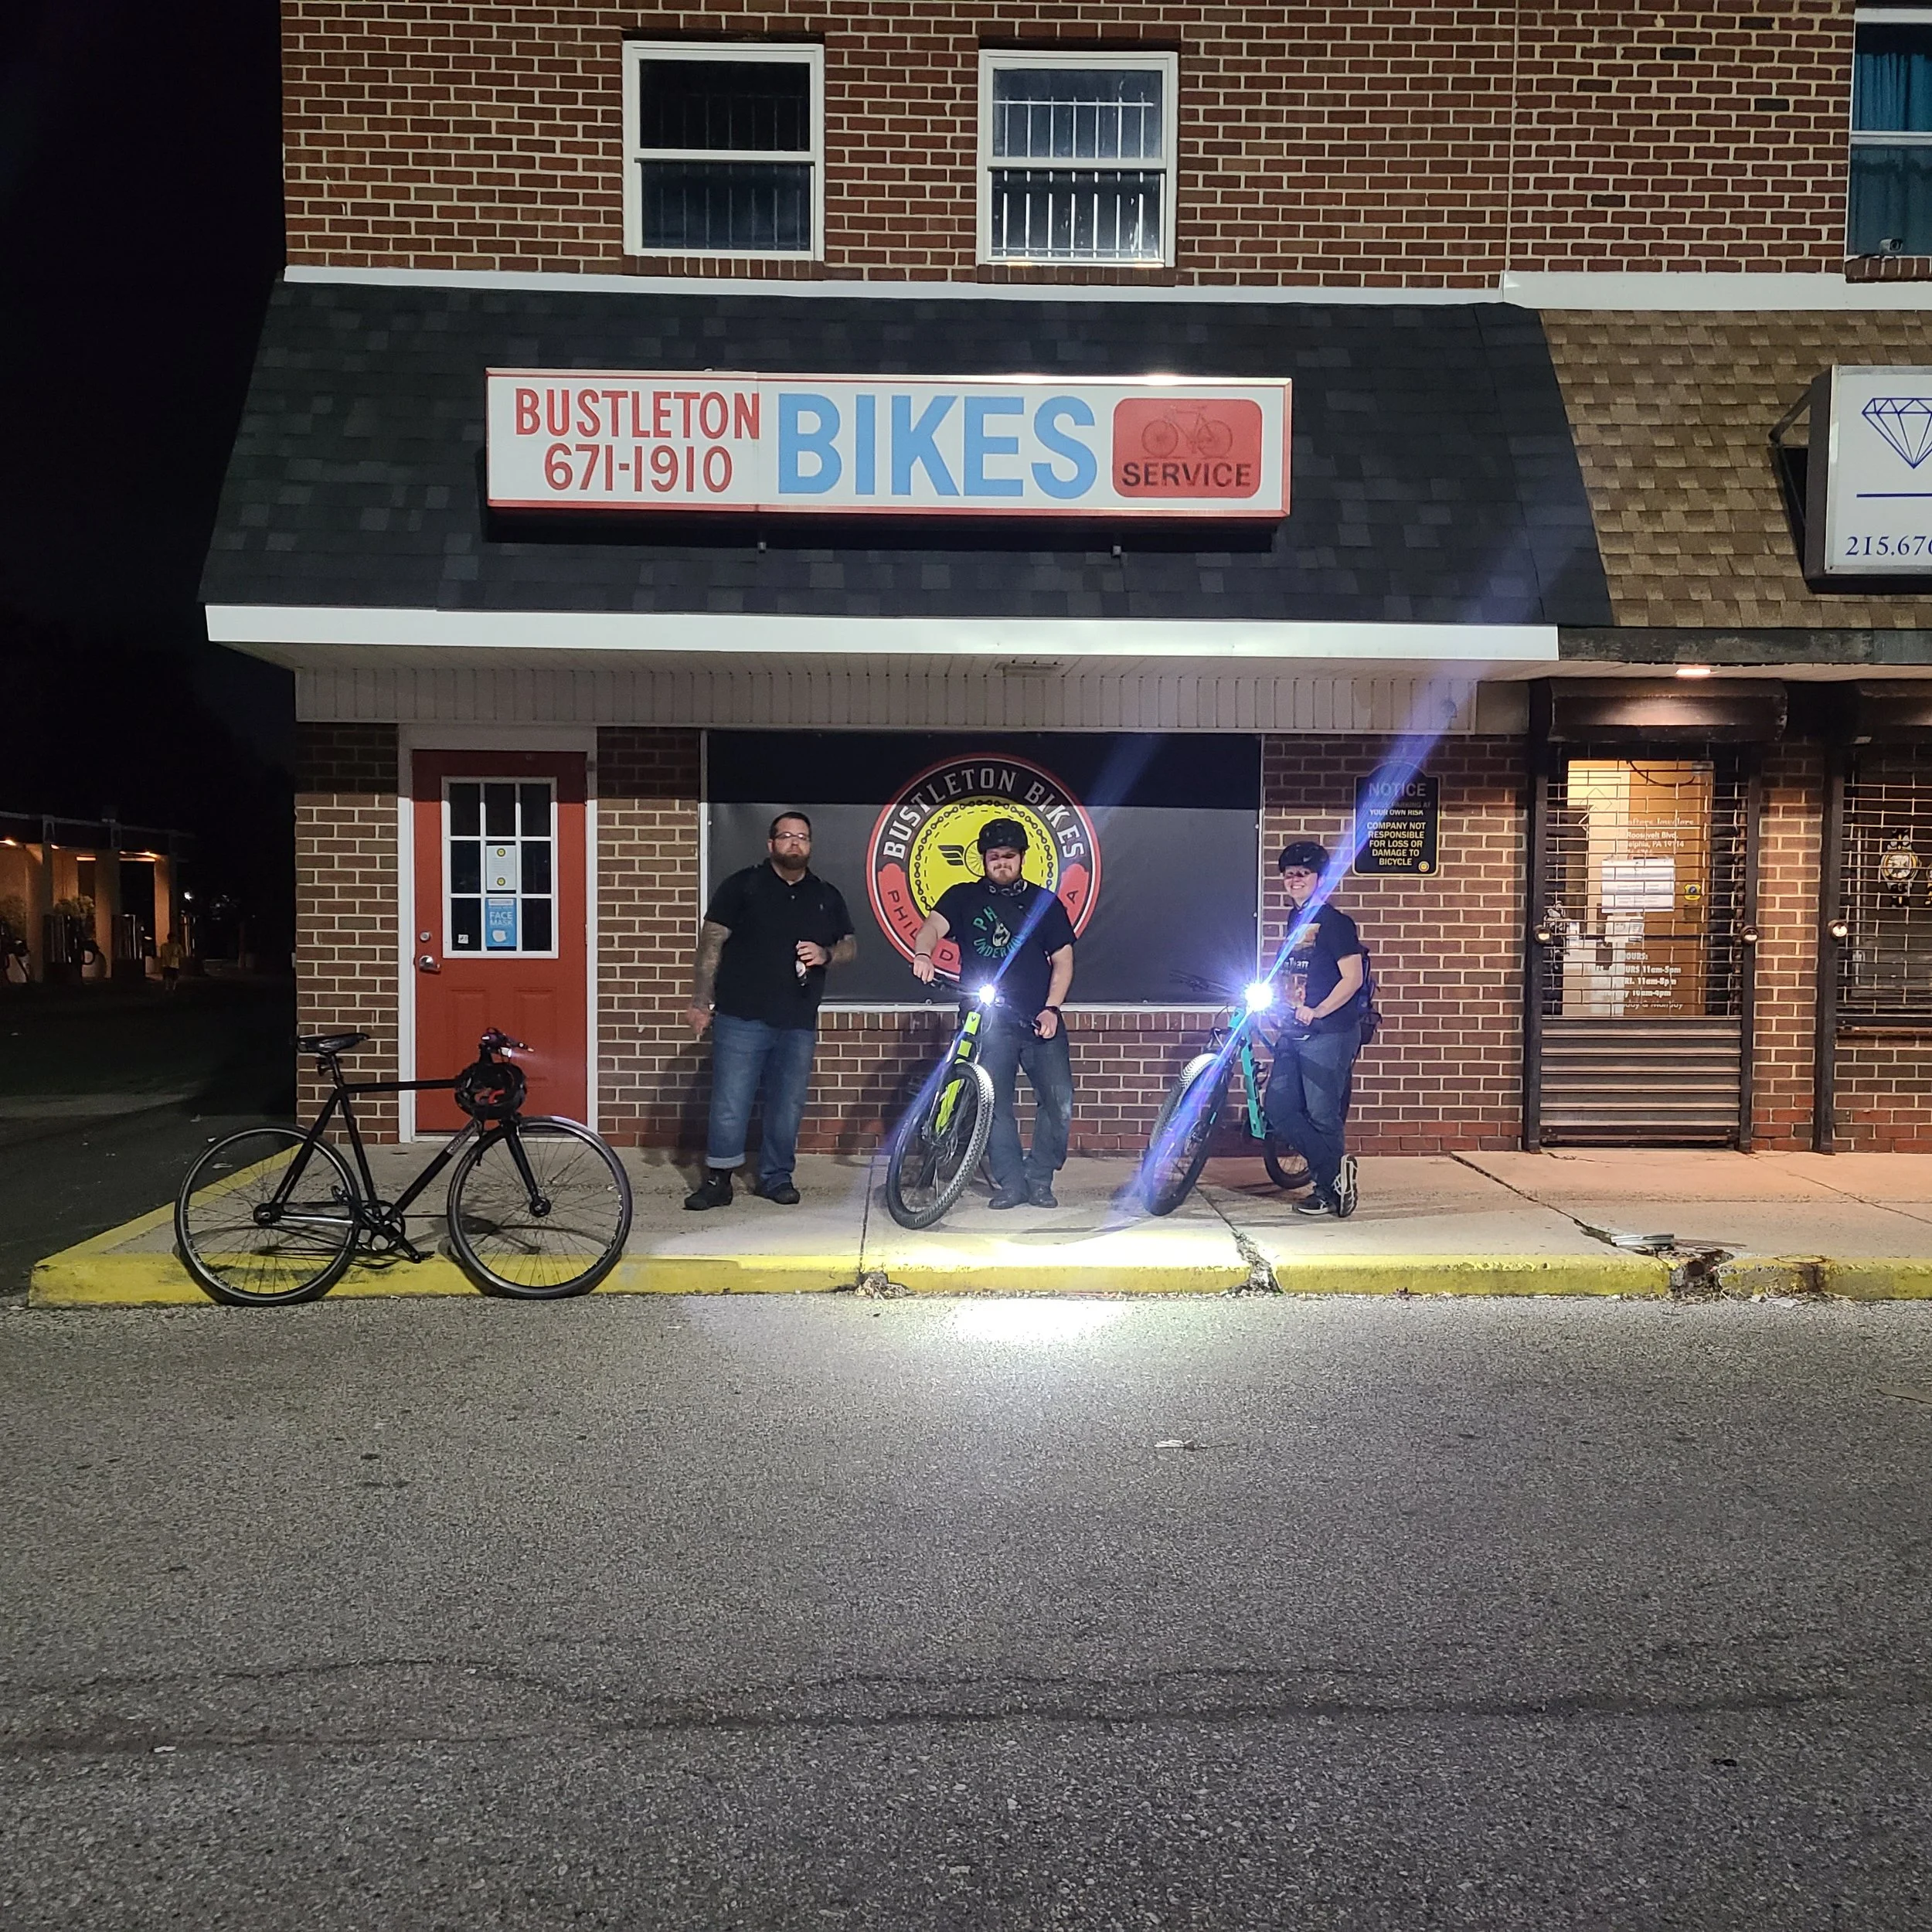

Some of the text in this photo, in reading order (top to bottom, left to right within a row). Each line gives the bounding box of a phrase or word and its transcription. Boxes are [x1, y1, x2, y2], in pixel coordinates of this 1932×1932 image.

[515, 387, 760, 440] BUSTLETON
[777, 393, 1097, 499] BIKES
[543, 443, 733, 493] 671-1910
[1122, 462, 1251, 488] SERVICE
[1369, 783, 1426, 796] NOTICE
[883, 767, 1086, 861] BUSTLETON BIKES
[489, 911, 513, 920] FACE
[1626, 952, 1648, 961] OURS:
